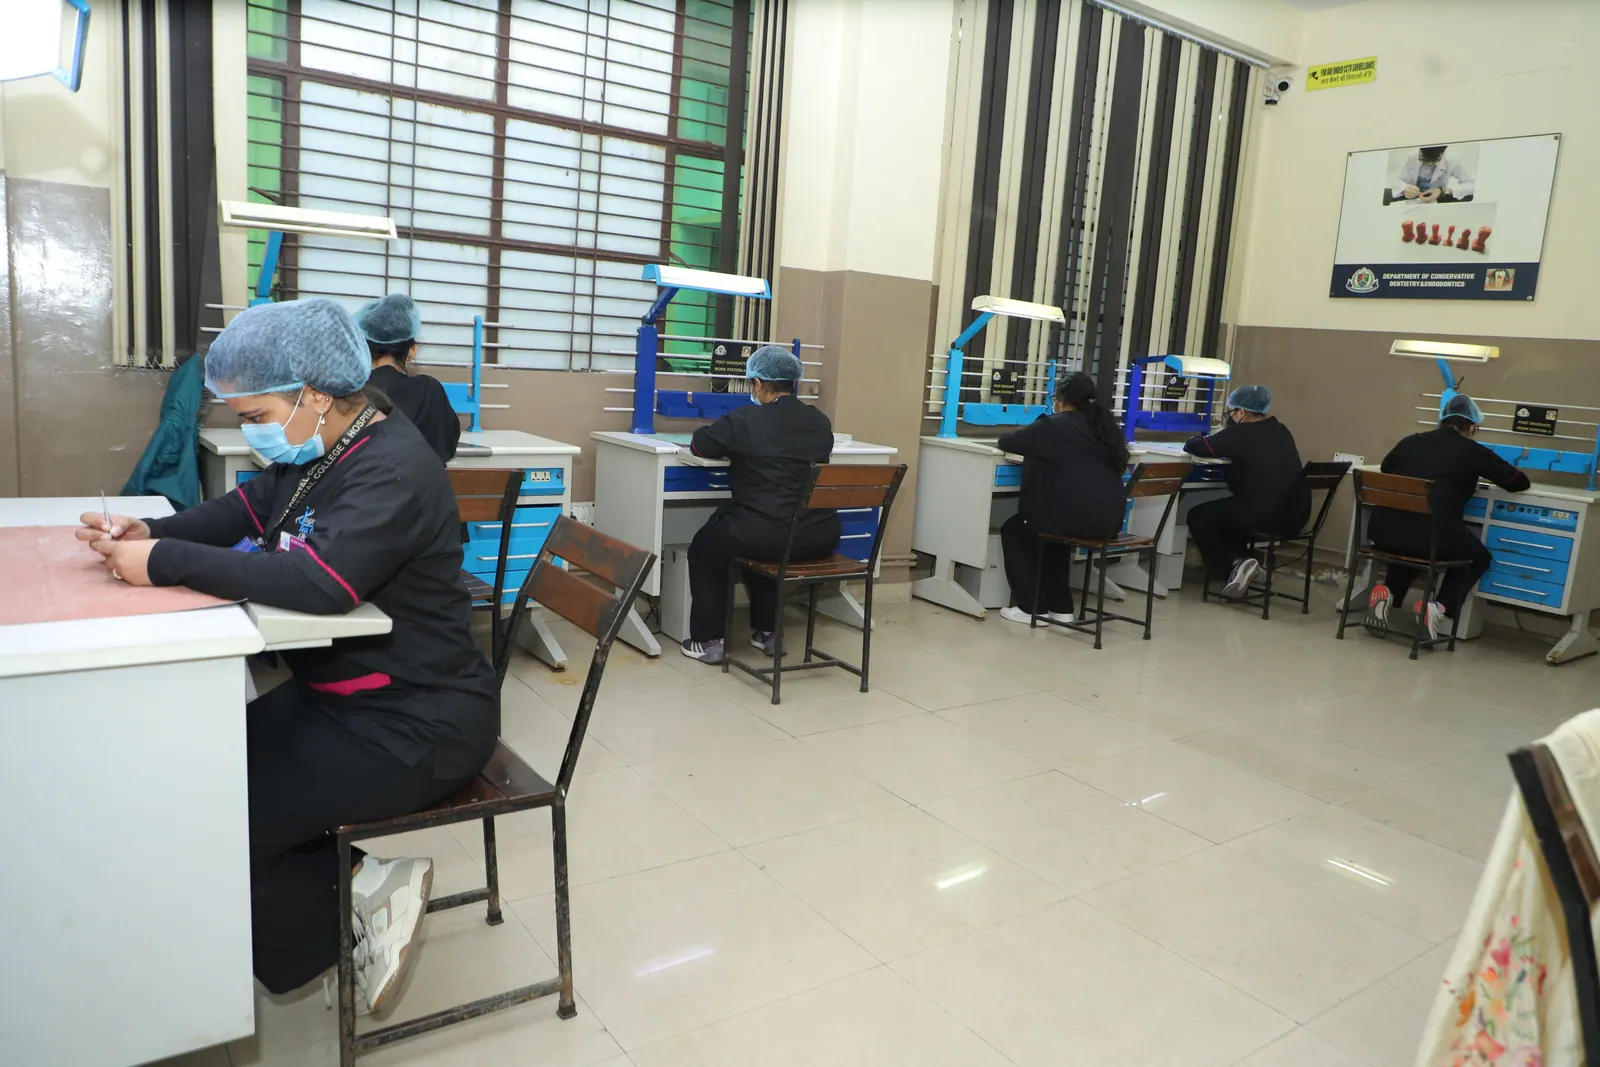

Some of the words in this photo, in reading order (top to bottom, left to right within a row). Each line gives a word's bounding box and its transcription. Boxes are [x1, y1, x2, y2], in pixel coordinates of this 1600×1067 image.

[1344, 64, 1352, 73] CCTV
[292, 480, 316, 509] DENTAL
[314, 444, 344, 479] COLLEGE
[347, 406, 375, 438] HOSPITAL
